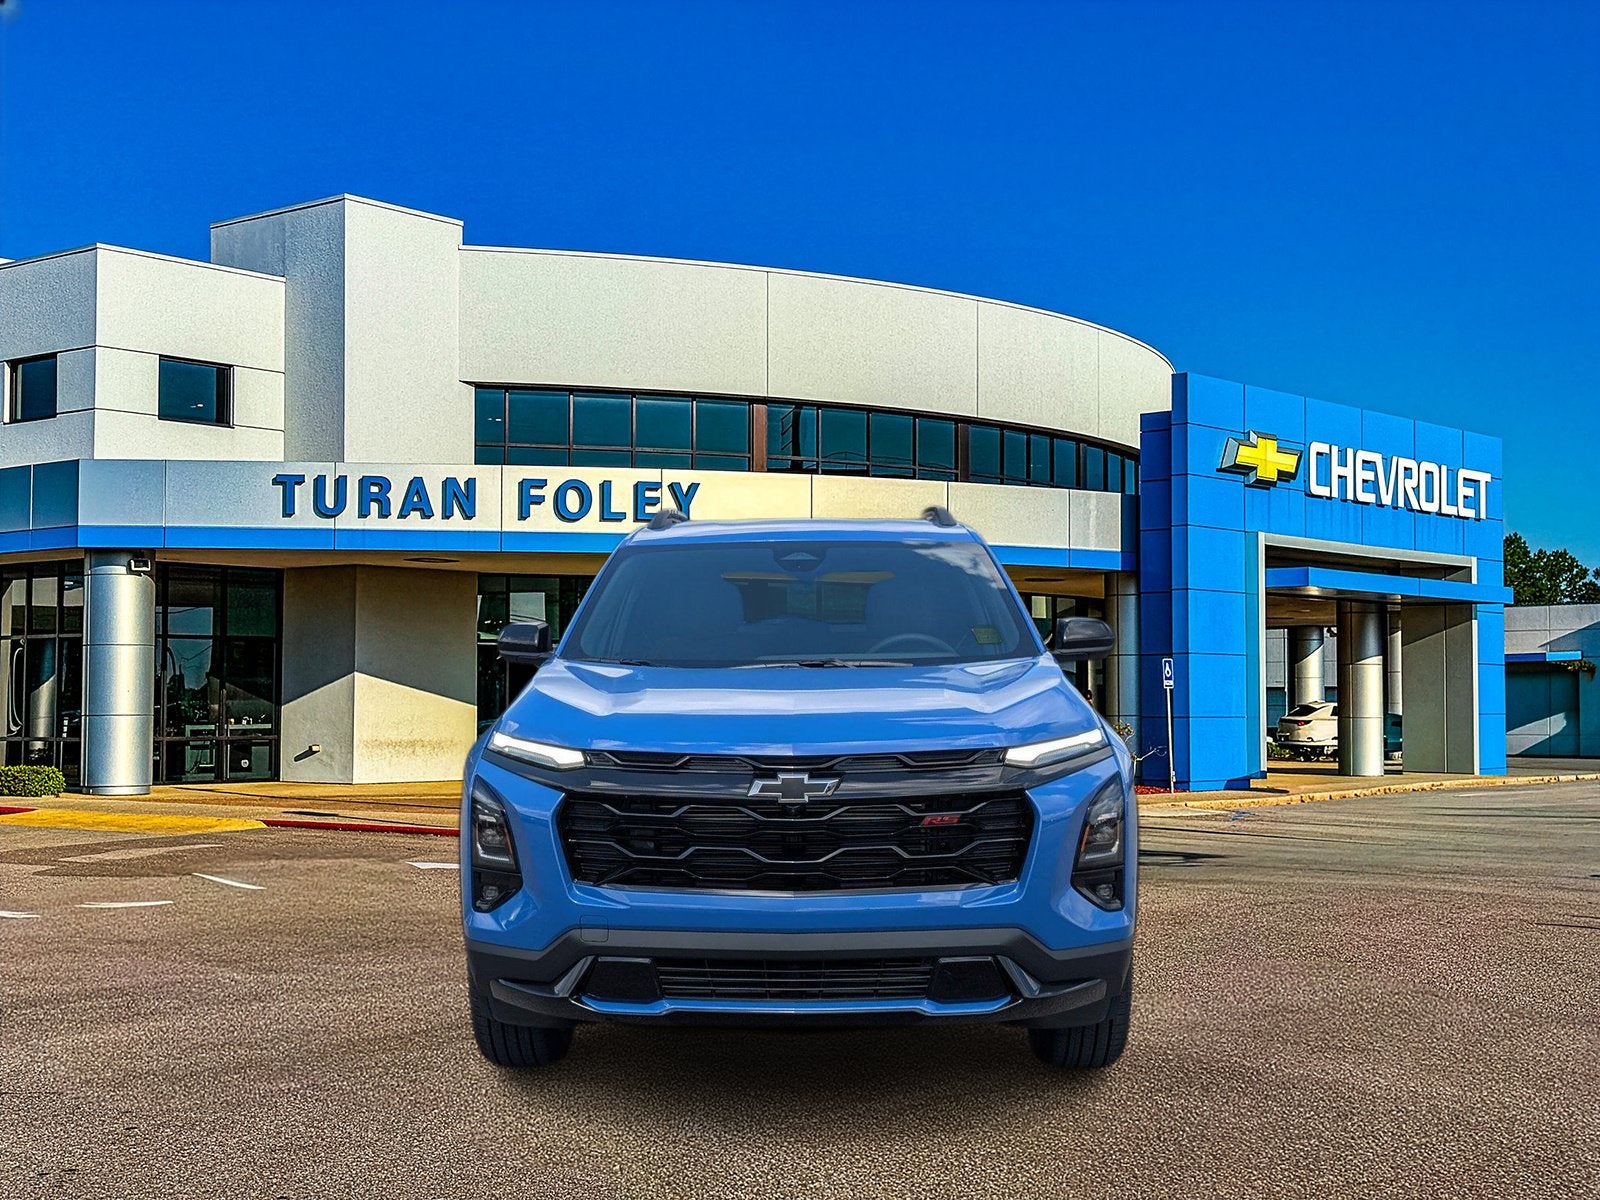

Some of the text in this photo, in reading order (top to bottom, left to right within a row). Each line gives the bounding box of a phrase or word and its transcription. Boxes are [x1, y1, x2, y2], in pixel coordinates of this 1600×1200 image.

[272, 474, 701, 523] TURAN FOLEY
[1308, 441, 1492, 520] CHEVROLET
[921, 815, 960, 827] RS
